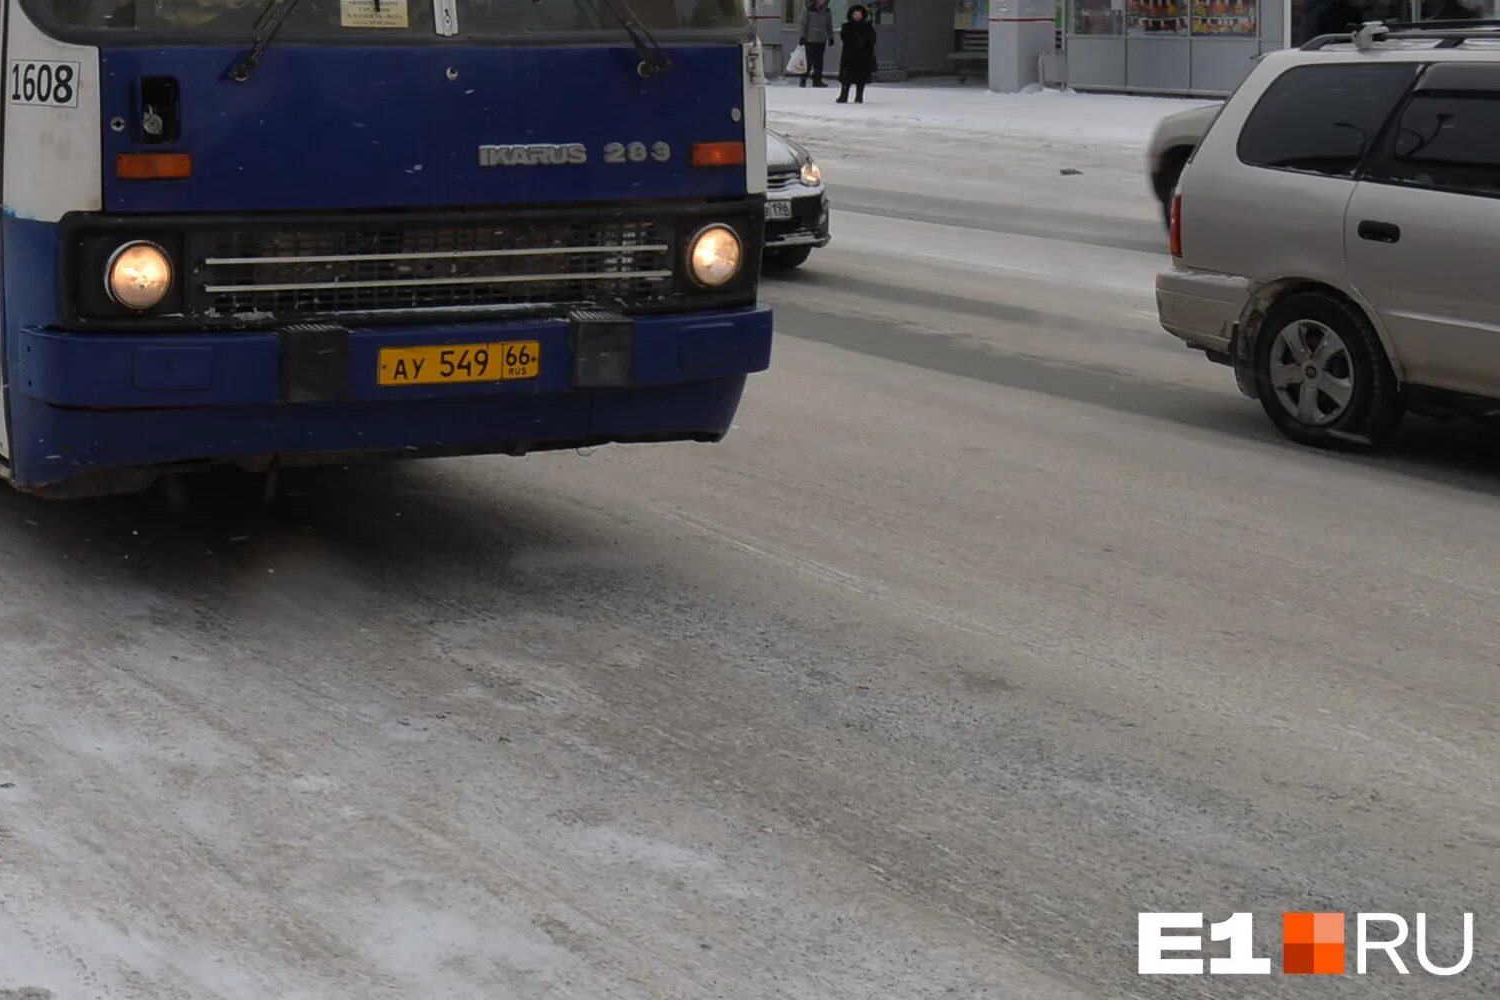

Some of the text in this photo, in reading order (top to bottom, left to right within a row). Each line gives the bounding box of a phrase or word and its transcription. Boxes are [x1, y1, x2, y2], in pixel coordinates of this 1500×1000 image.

[12, 63, 73, 103] 1608
[479, 141, 671, 166] IKARUS 283
[440, 349, 489, 377] 549
[505, 345, 531, 366] 66
[508, 367, 528, 376] RUS
